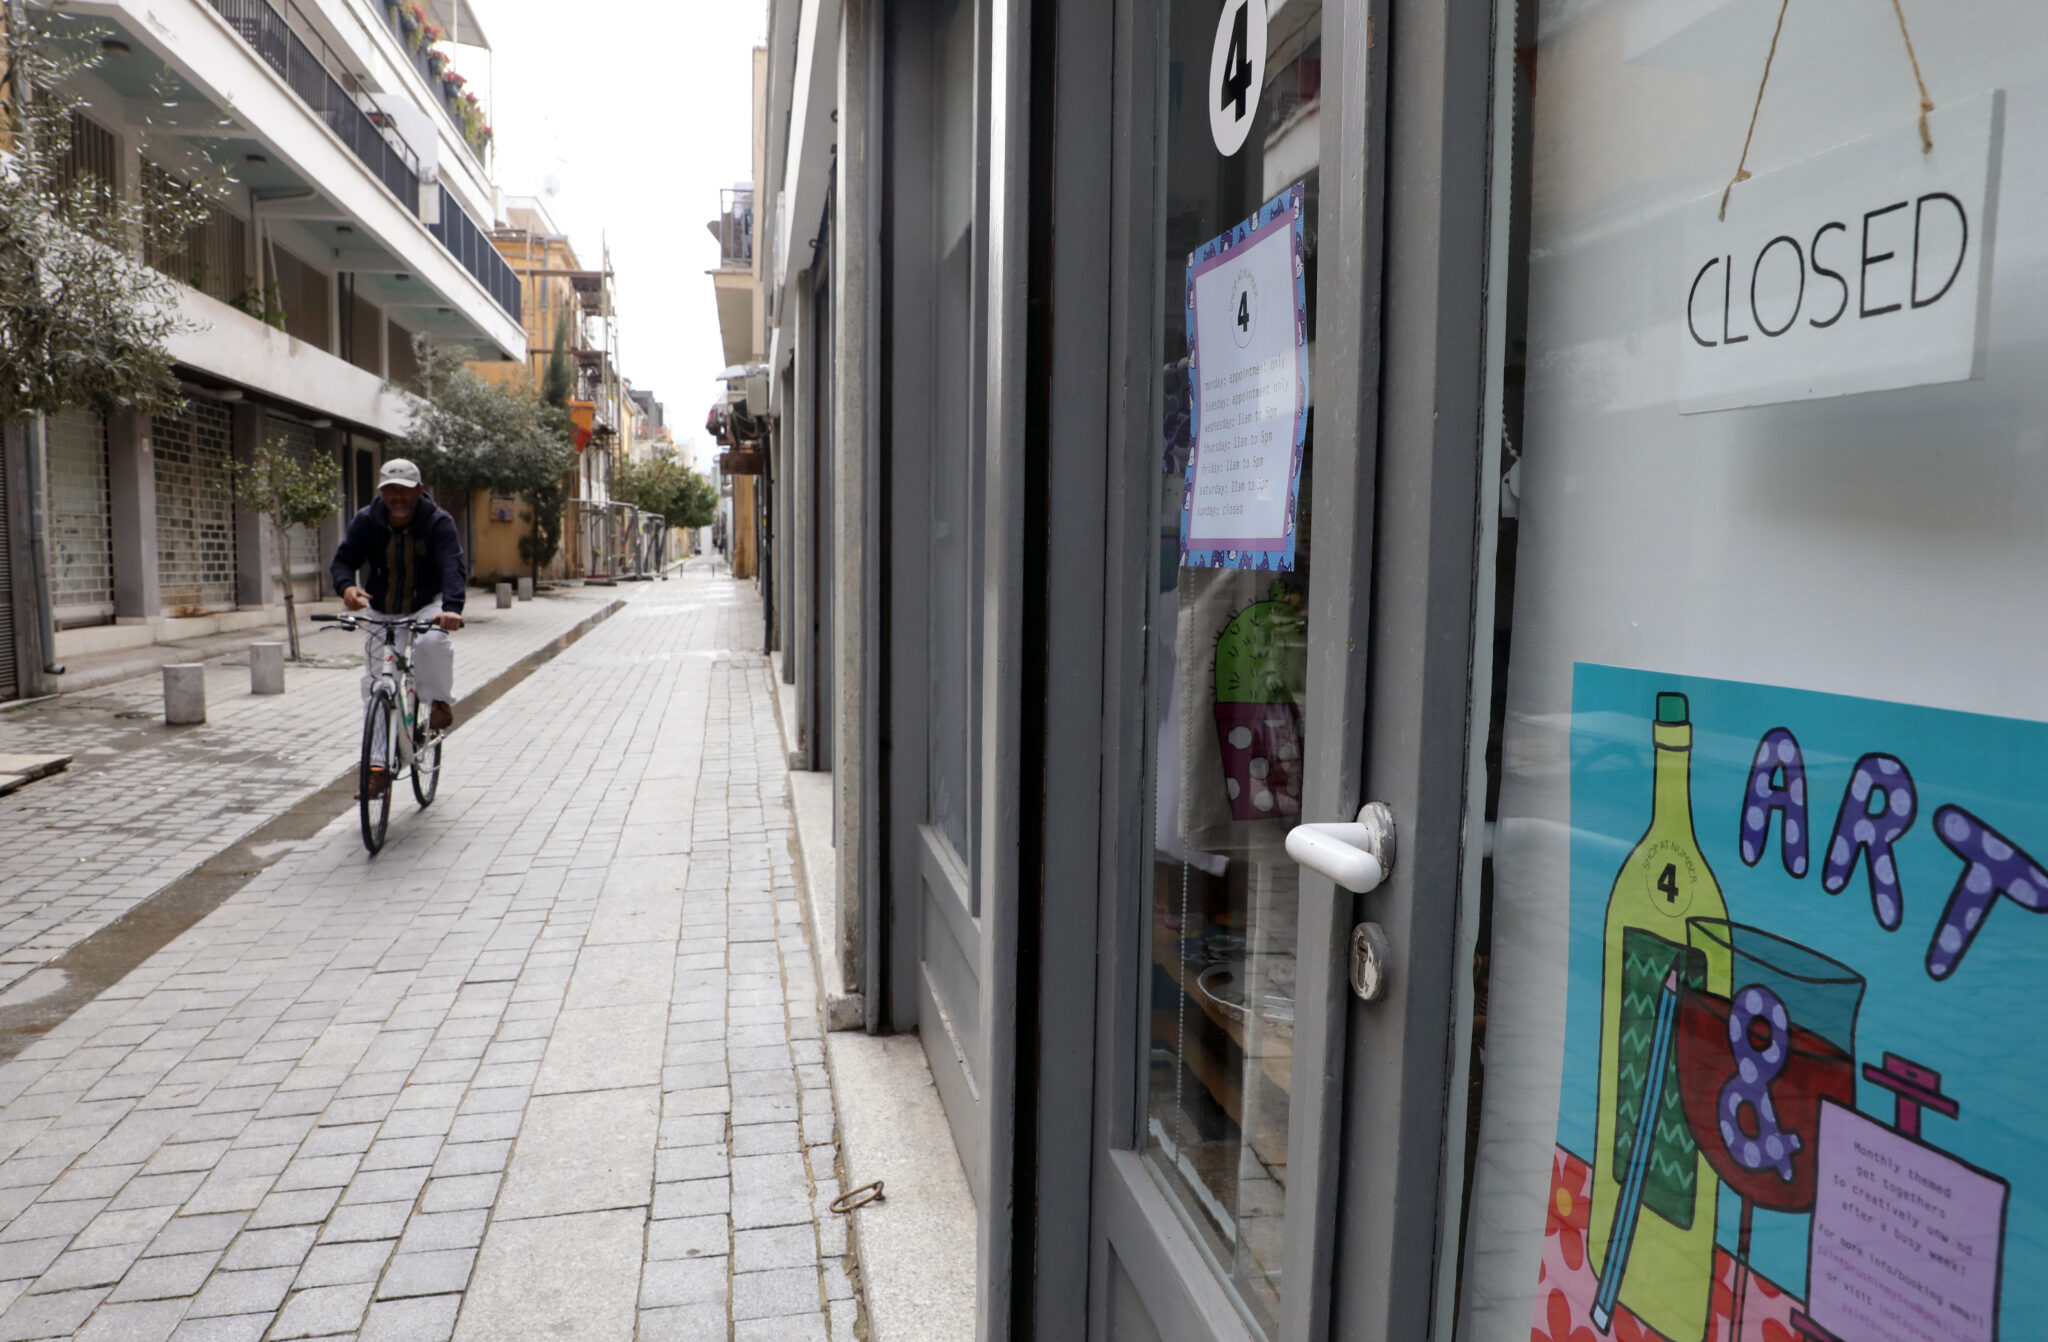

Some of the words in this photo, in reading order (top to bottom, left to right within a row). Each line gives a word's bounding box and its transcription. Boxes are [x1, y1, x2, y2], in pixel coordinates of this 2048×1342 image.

[1221, 0, 1252, 123] 4
[1687, 192, 1968, 347] CLOSED
[1237, 290, 1250, 332] 4
[1204, 376, 1226, 392] monday:
[1229, 361, 1267, 385] appointment
[1270, 353, 1285, 371] only
[1205, 397, 1230, 413] tuesday:
[1232, 384, 1271, 408] appointment
[1273, 376, 1289, 392] only
[1203, 440, 1231, 454] thursday:
[1233, 435, 1248, 449] 11am
[1250, 433, 1258, 445] to
[1261, 430, 1273, 446] 5pm
[1204, 418, 1235, 433] wednesday:
[1237, 412, 1252, 425] 11am
[1202, 462, 1223, 475] friday:
[1226, 459, 1240, 472] 11am
[1242, 457, 1250, 469] to
[1252, 455, 1264, 470] 5pm
[1196, 505, 1220, 518] sunday:
[1222, 501, 1244, 516] closed
[1199, 482, 1228, 497] saturday:
[1231, 480, 1245, 493] 11am
[1247, 479, 1256, 491] to
[1643, 842, 1658, 871] SHOP
[1660, 840, 1670, 850] AT
[1671, 842, 1698, 884] NUMBER
[1739, 726, 2048, 982] ART
[1657, 862, 1679, 904] 4
[1716, 983, 1804, 1186] &
[1854, 1141, 1900, 1174] Monthly
[1907, 1169, 1952, 1199] themed
[1833, 1173, 1846, 1188] to
[1851, 1185, 1920, 1229] creatively
[1856, 1165, 1876, 1183] get
[1882, 1178, 1946, 1219] togethers
[1841, 1200, 1874, 1223] after
[1880, 1222, 1888, 1232] a
[1894, 1227, 1922, 1252] busy
[1929, 1249, 1966, 1277] week!
[1818, 1223, 1835, 1239] For
[1840, 1237, 1864, 1257] more
[1869, 1253, 1944, 1306] info/booking
[1826, 1271, 1839, 1284] or
[1843, 1282, 1873, 1306] visit
